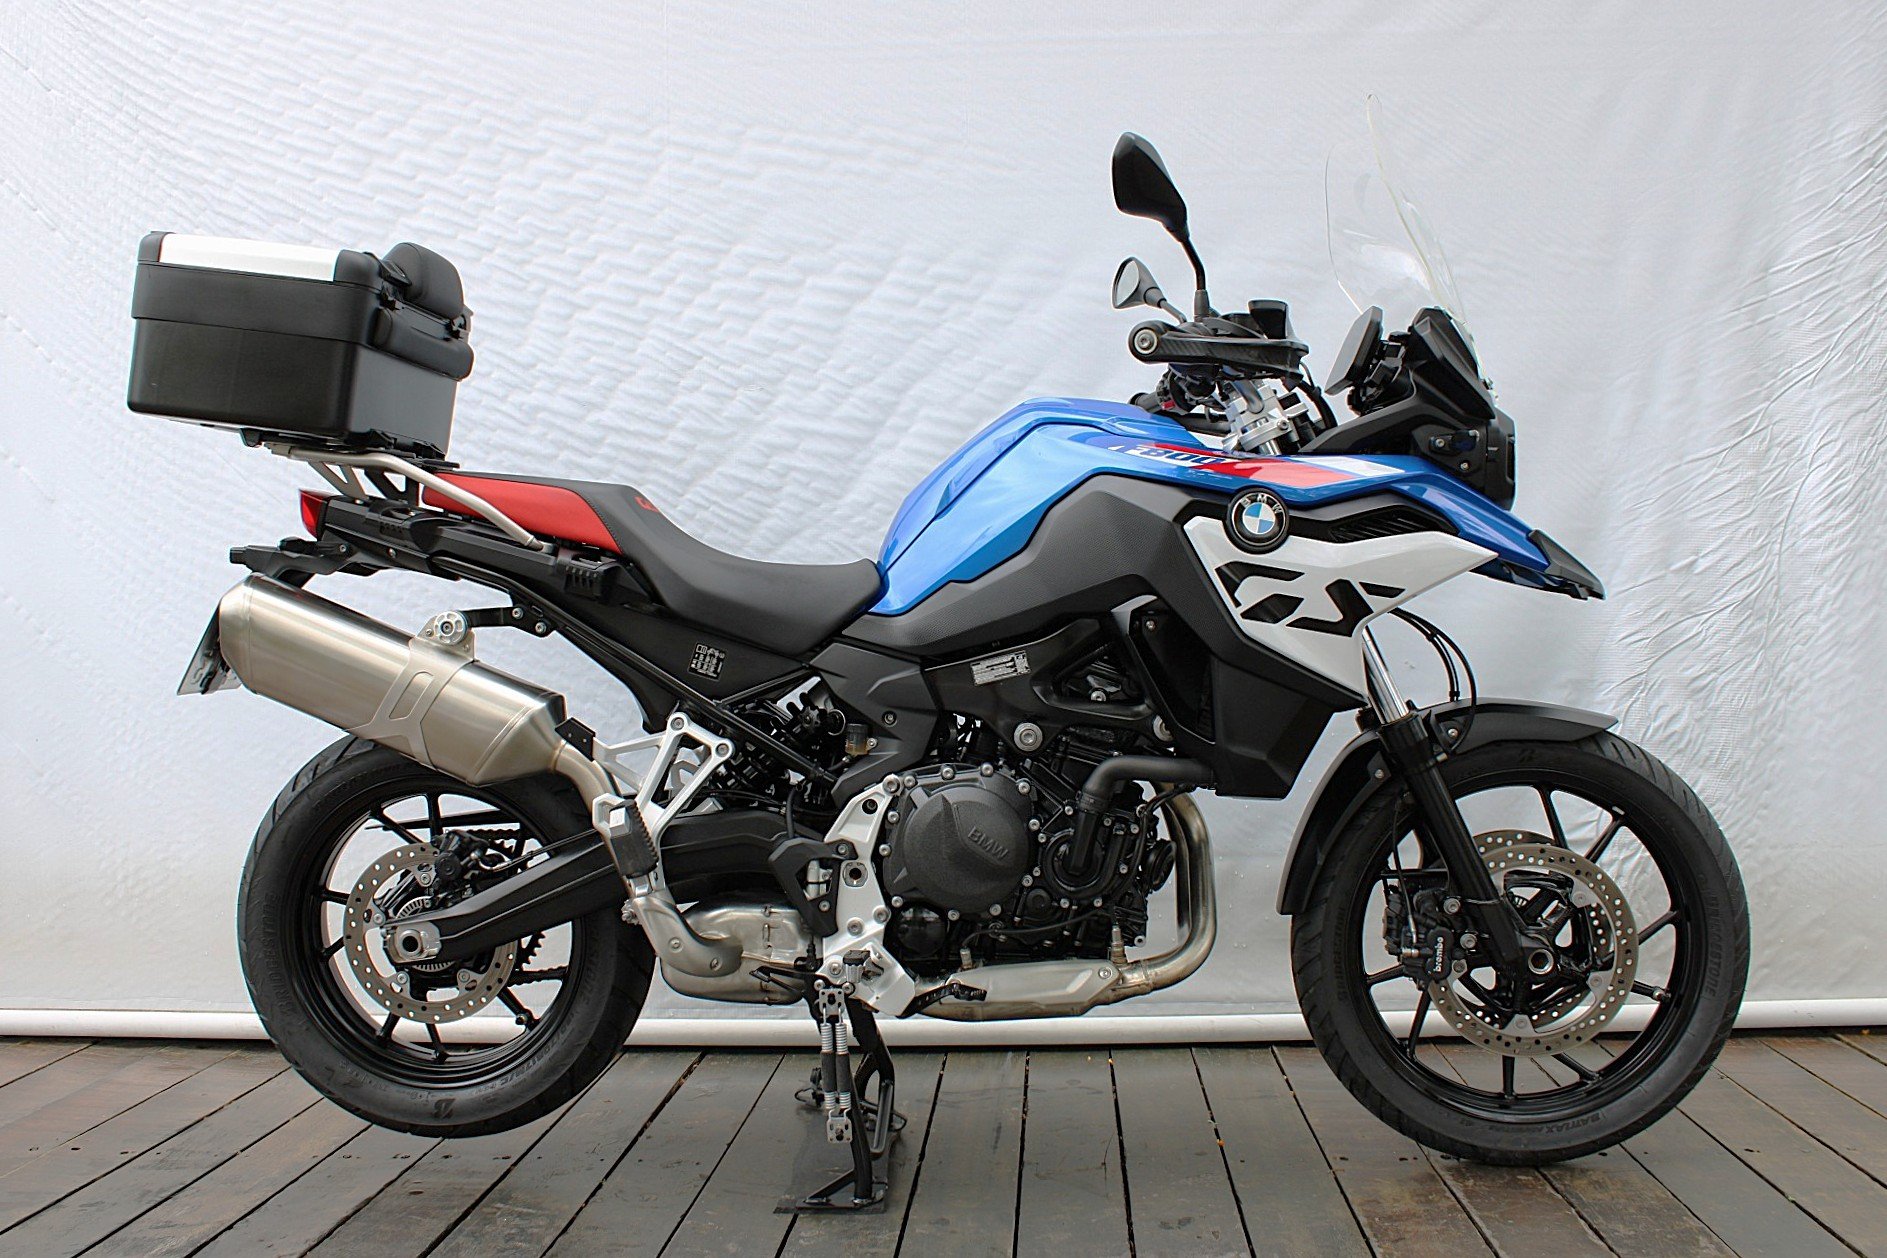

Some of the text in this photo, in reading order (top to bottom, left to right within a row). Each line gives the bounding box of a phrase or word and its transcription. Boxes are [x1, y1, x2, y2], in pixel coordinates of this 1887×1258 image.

[1240, 493, 1284, 514] BMW
[967, 825, 1009, 859] BMW
[1433, 936, 1444, 972] brembo
